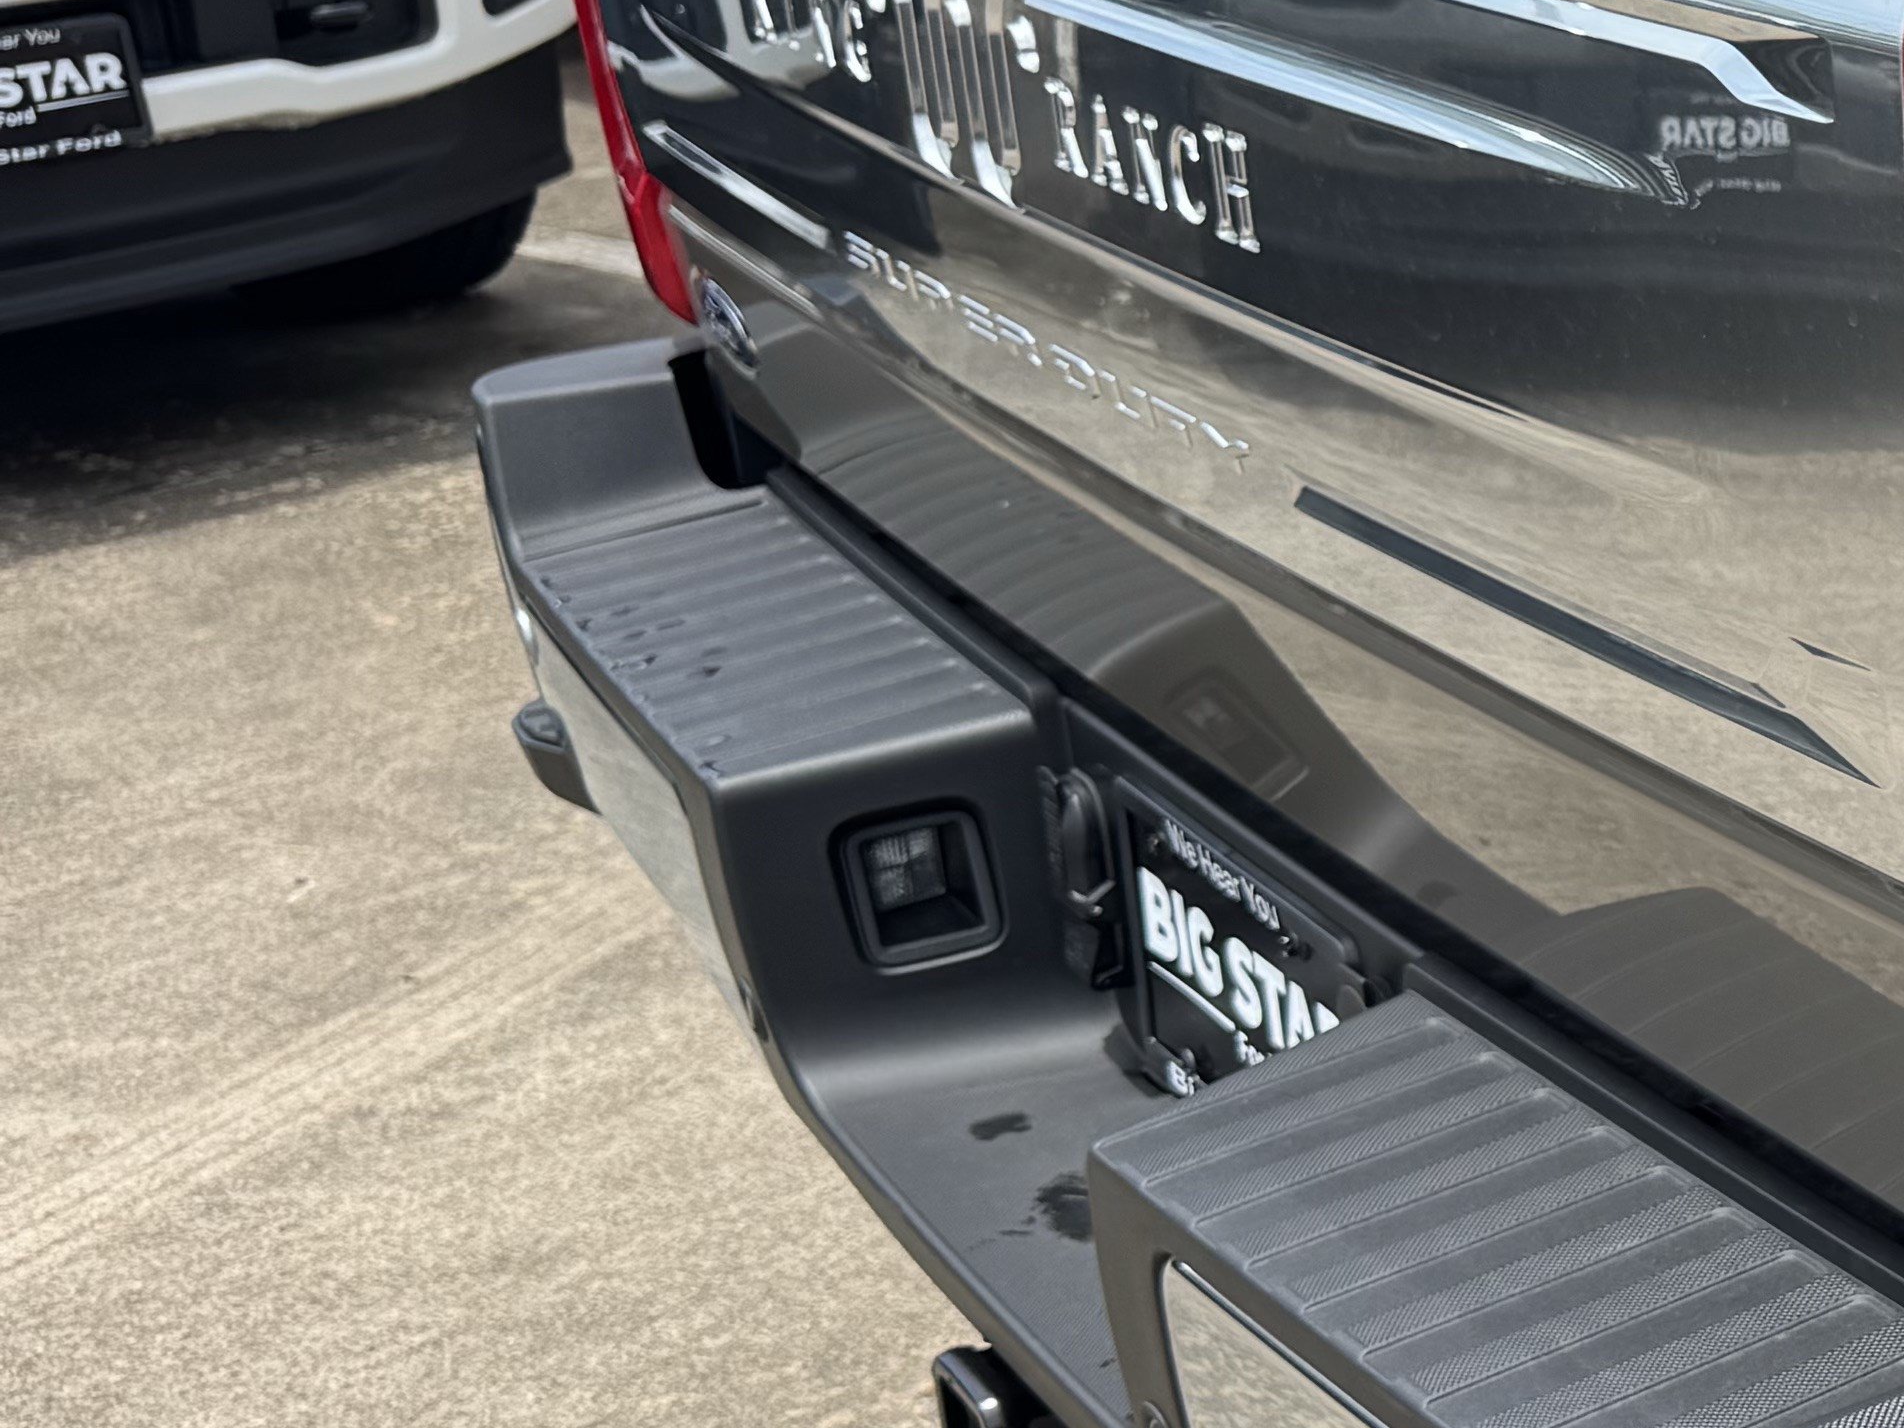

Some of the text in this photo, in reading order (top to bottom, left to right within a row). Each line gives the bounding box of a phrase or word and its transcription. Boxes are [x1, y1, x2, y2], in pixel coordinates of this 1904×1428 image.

[0, 52, 128, 109] STAR
[25, 28, 61, 47] You
[55, 129, 122, 156] Ford
[1044, 75, 1261, 254] RANCH
[843, 229, 1251, 476] SUPER DUTY
[1164, 818, 1281, 930] We Hear You
[1137, 866, 1340, 1051] BIG STA
